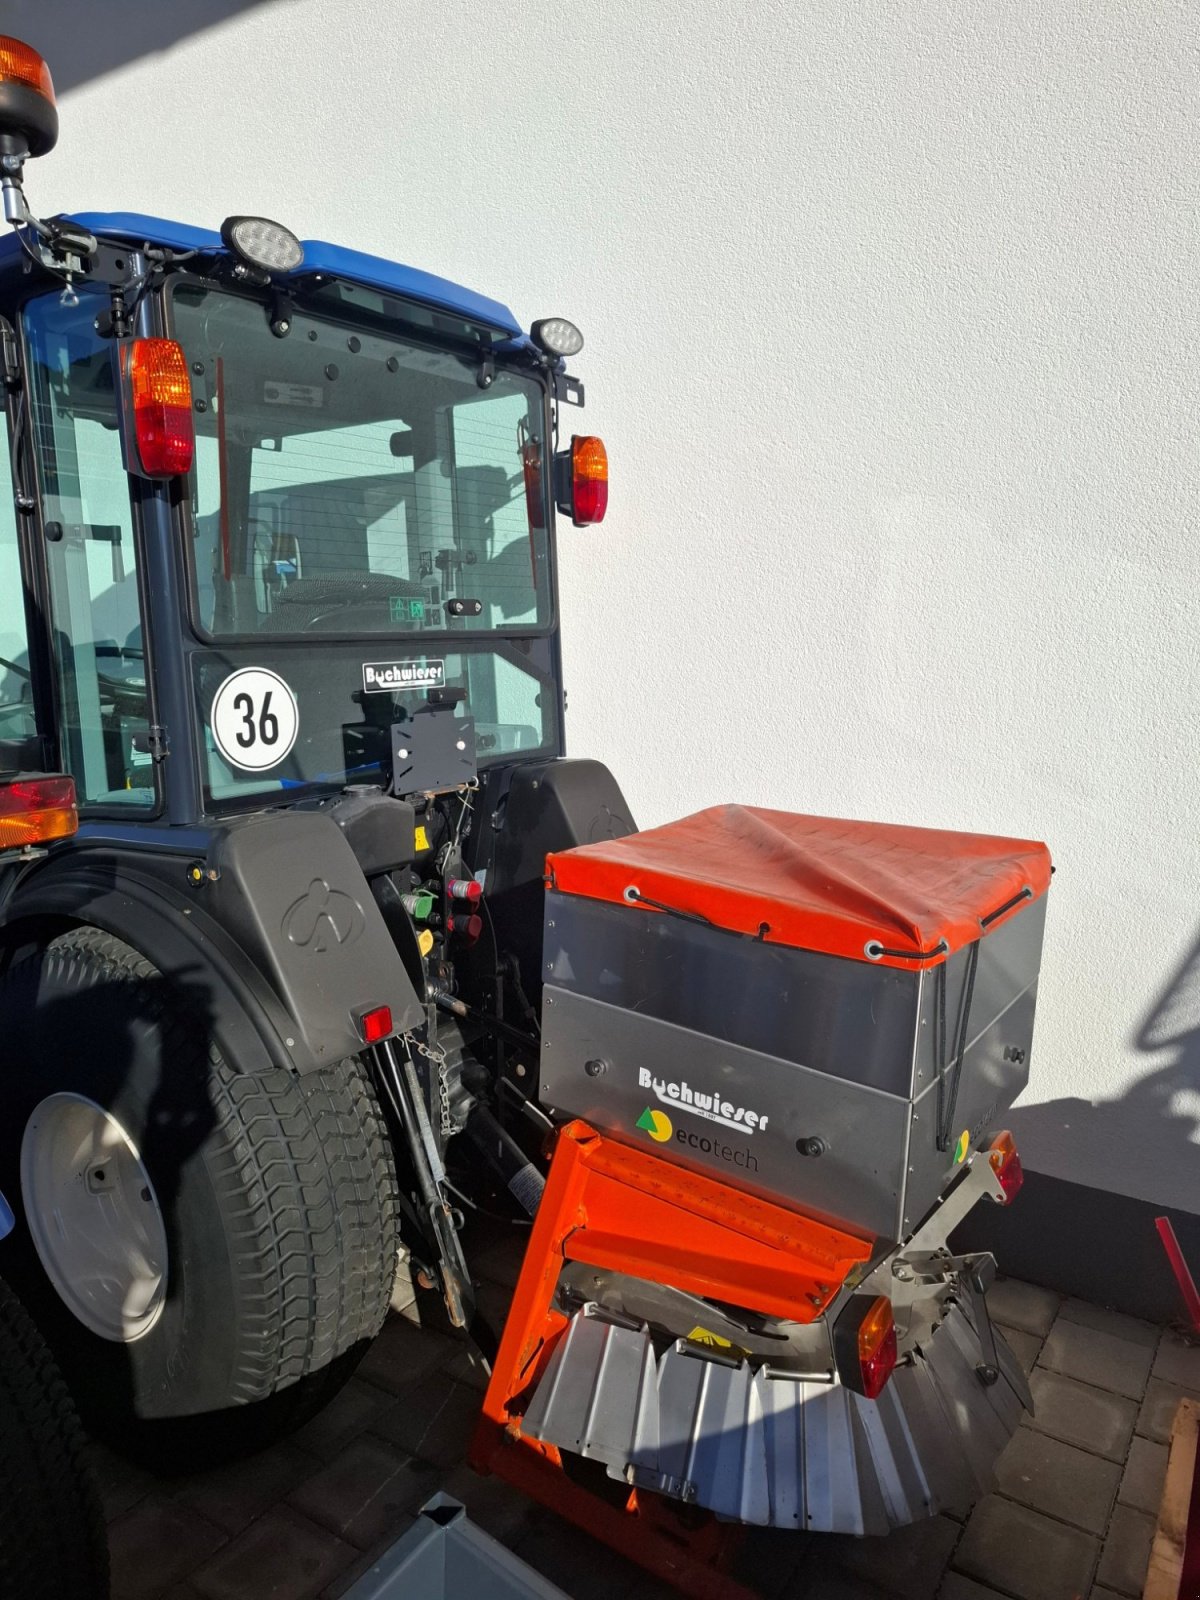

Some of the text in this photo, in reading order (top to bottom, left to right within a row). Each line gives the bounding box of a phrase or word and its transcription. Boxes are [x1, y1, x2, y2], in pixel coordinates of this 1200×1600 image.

[365, 664, 442, 685] Buchwieser
[233, 691, 279, 748] 36
[638, 1066, 769, 1132] Buchwieser
[676, 1128, 759, 1172] ecotech
